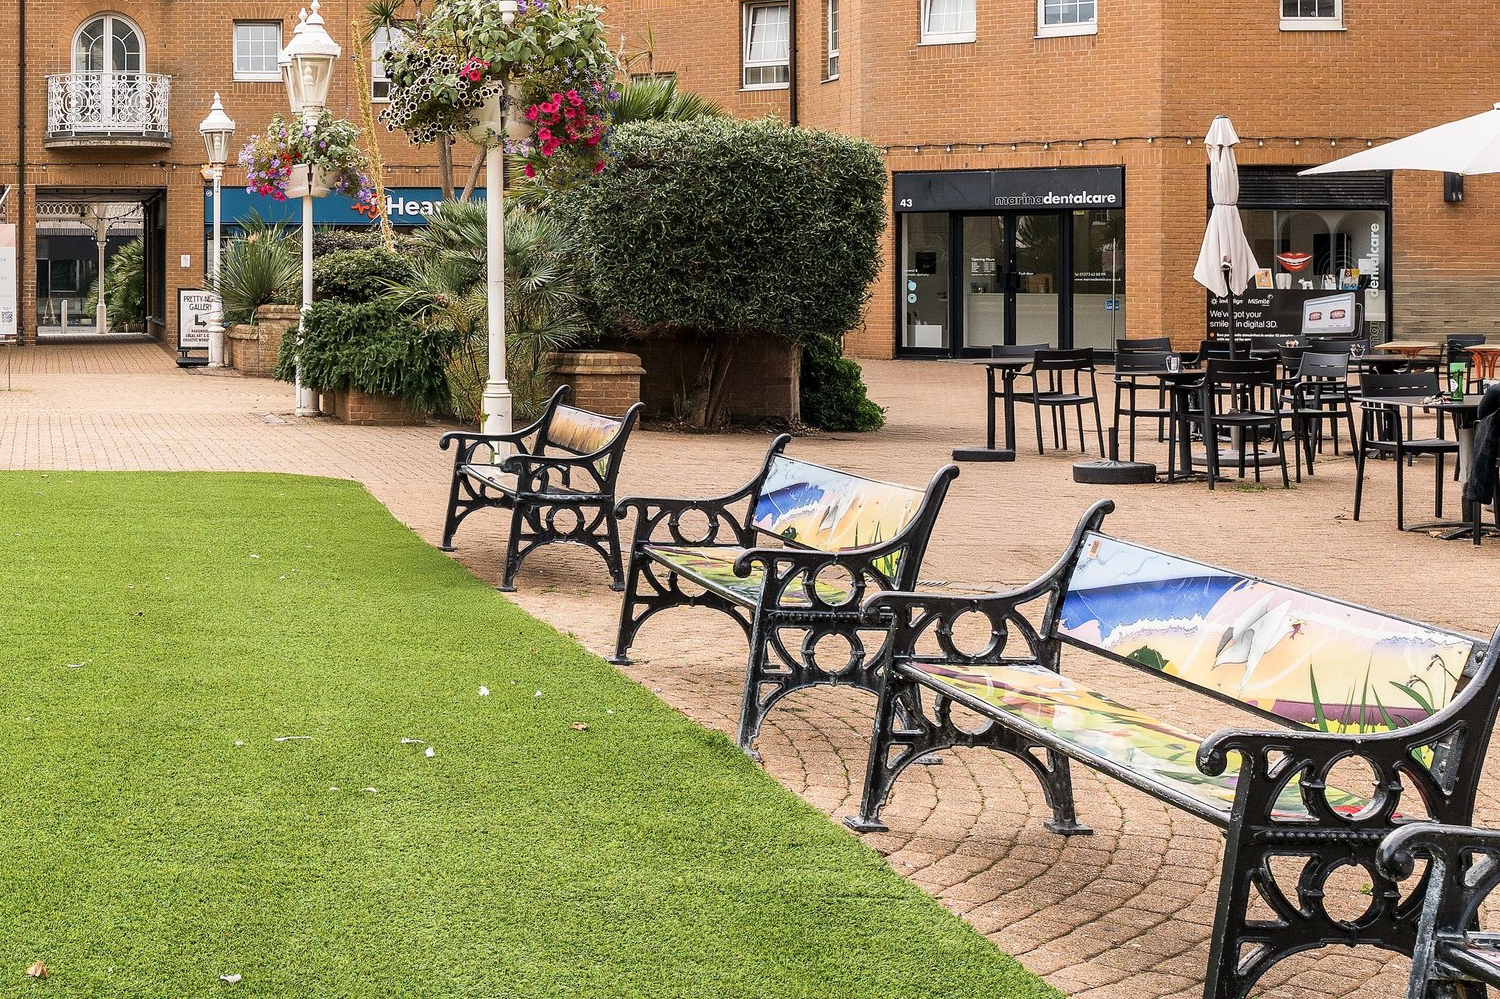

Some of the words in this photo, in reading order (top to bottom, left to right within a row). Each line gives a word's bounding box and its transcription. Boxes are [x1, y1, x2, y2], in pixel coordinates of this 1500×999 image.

[900, 198, 913, 208] 43
[1210, 320, 1229, 328] smile
[1236, 320, 1242, 328] in
[1243, 320, 1265, 329] digital
[1265, 320, 1278, 328] 3D.
